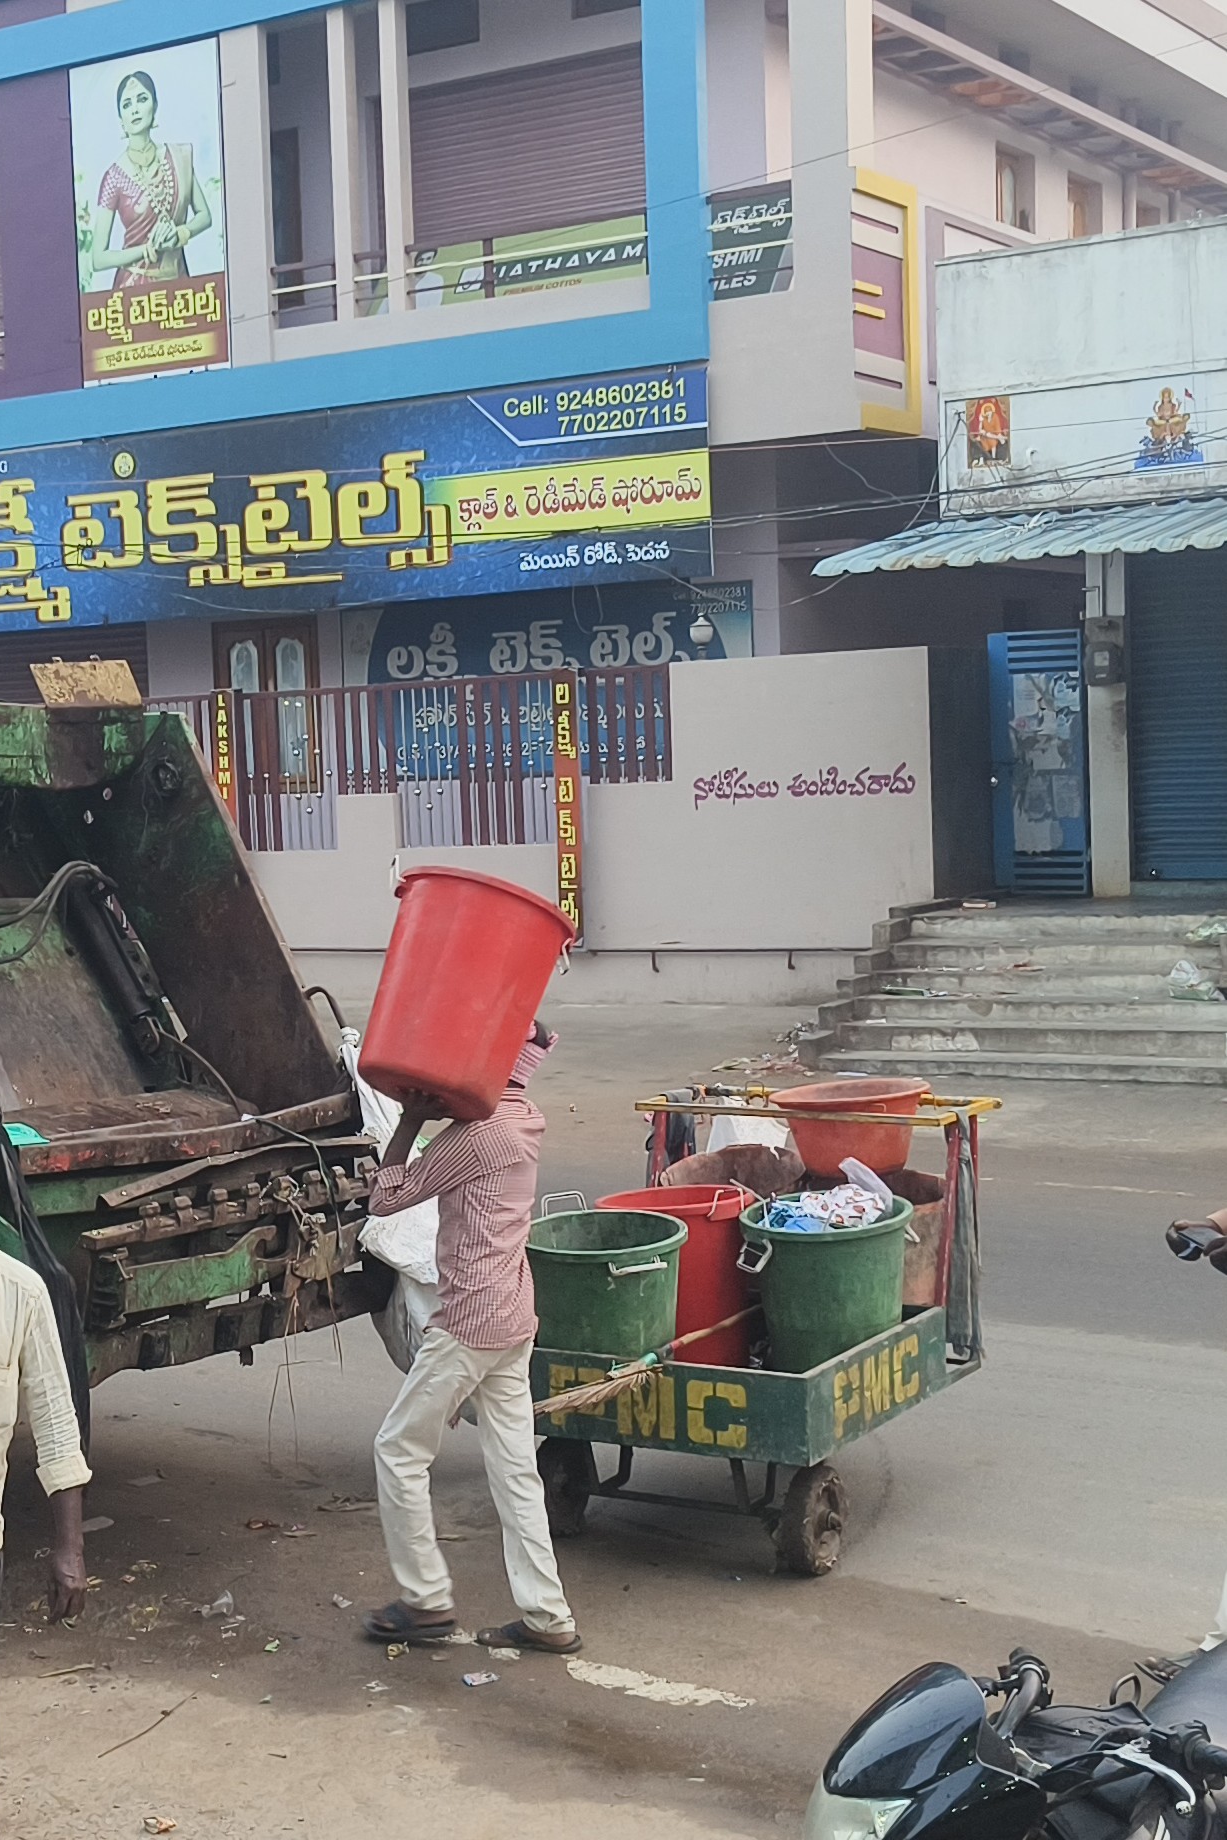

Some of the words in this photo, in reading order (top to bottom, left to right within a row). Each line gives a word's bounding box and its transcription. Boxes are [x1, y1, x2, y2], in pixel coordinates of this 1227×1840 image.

[87, 291, 132, 342] లక్ష్మీ
[503, 394, 549, 417] Cell:
[556, 377, 685, 411] 9248602381
[558, 402, 687, 435] 7702207115
[458, 487, 498, 531] క్లాత్
[504, 494, 519, 517] &
[523, 476, 606, 515] రెడీమేడ్
[611, 467, 703, 515] షోరూమ్
[217, 694, 231, 800] LAKSHMI
[693, 767, 779, 810] నోటీసులు
[786, 762, 916, 798] అంటించరాదు
[833, 1334, 920, 1440] PMC
